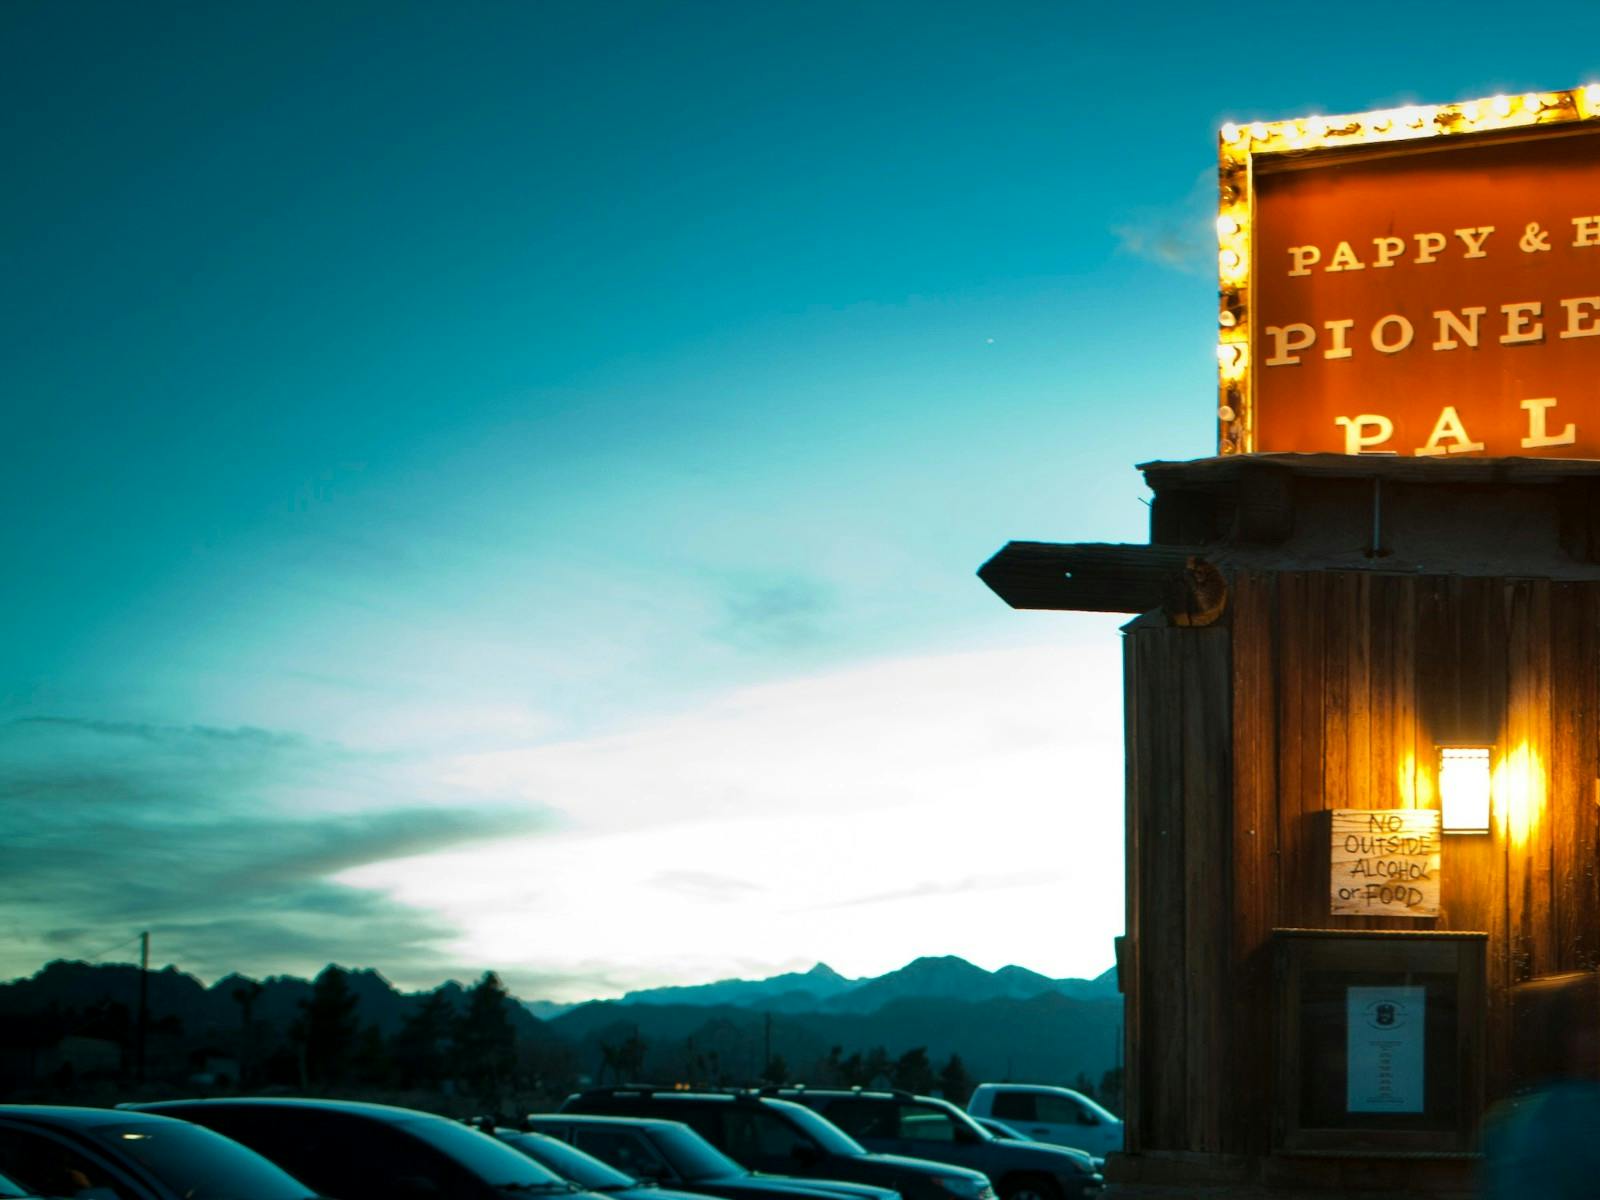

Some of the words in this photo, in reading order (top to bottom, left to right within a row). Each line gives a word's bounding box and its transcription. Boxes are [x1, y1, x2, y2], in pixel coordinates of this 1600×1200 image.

[1288, 225, 1495, 277] PAPPY
[1518, 222, 1551, 254] &
[1369, 814, 1402, 833] NO
[1344, 835, 1431, 855] OUTSIDE
[1350, 858, 1431, 880] ALCOHOL
[1339, 888, 1361, 900] or
[1365, 884, 1423, 907] FOOD
